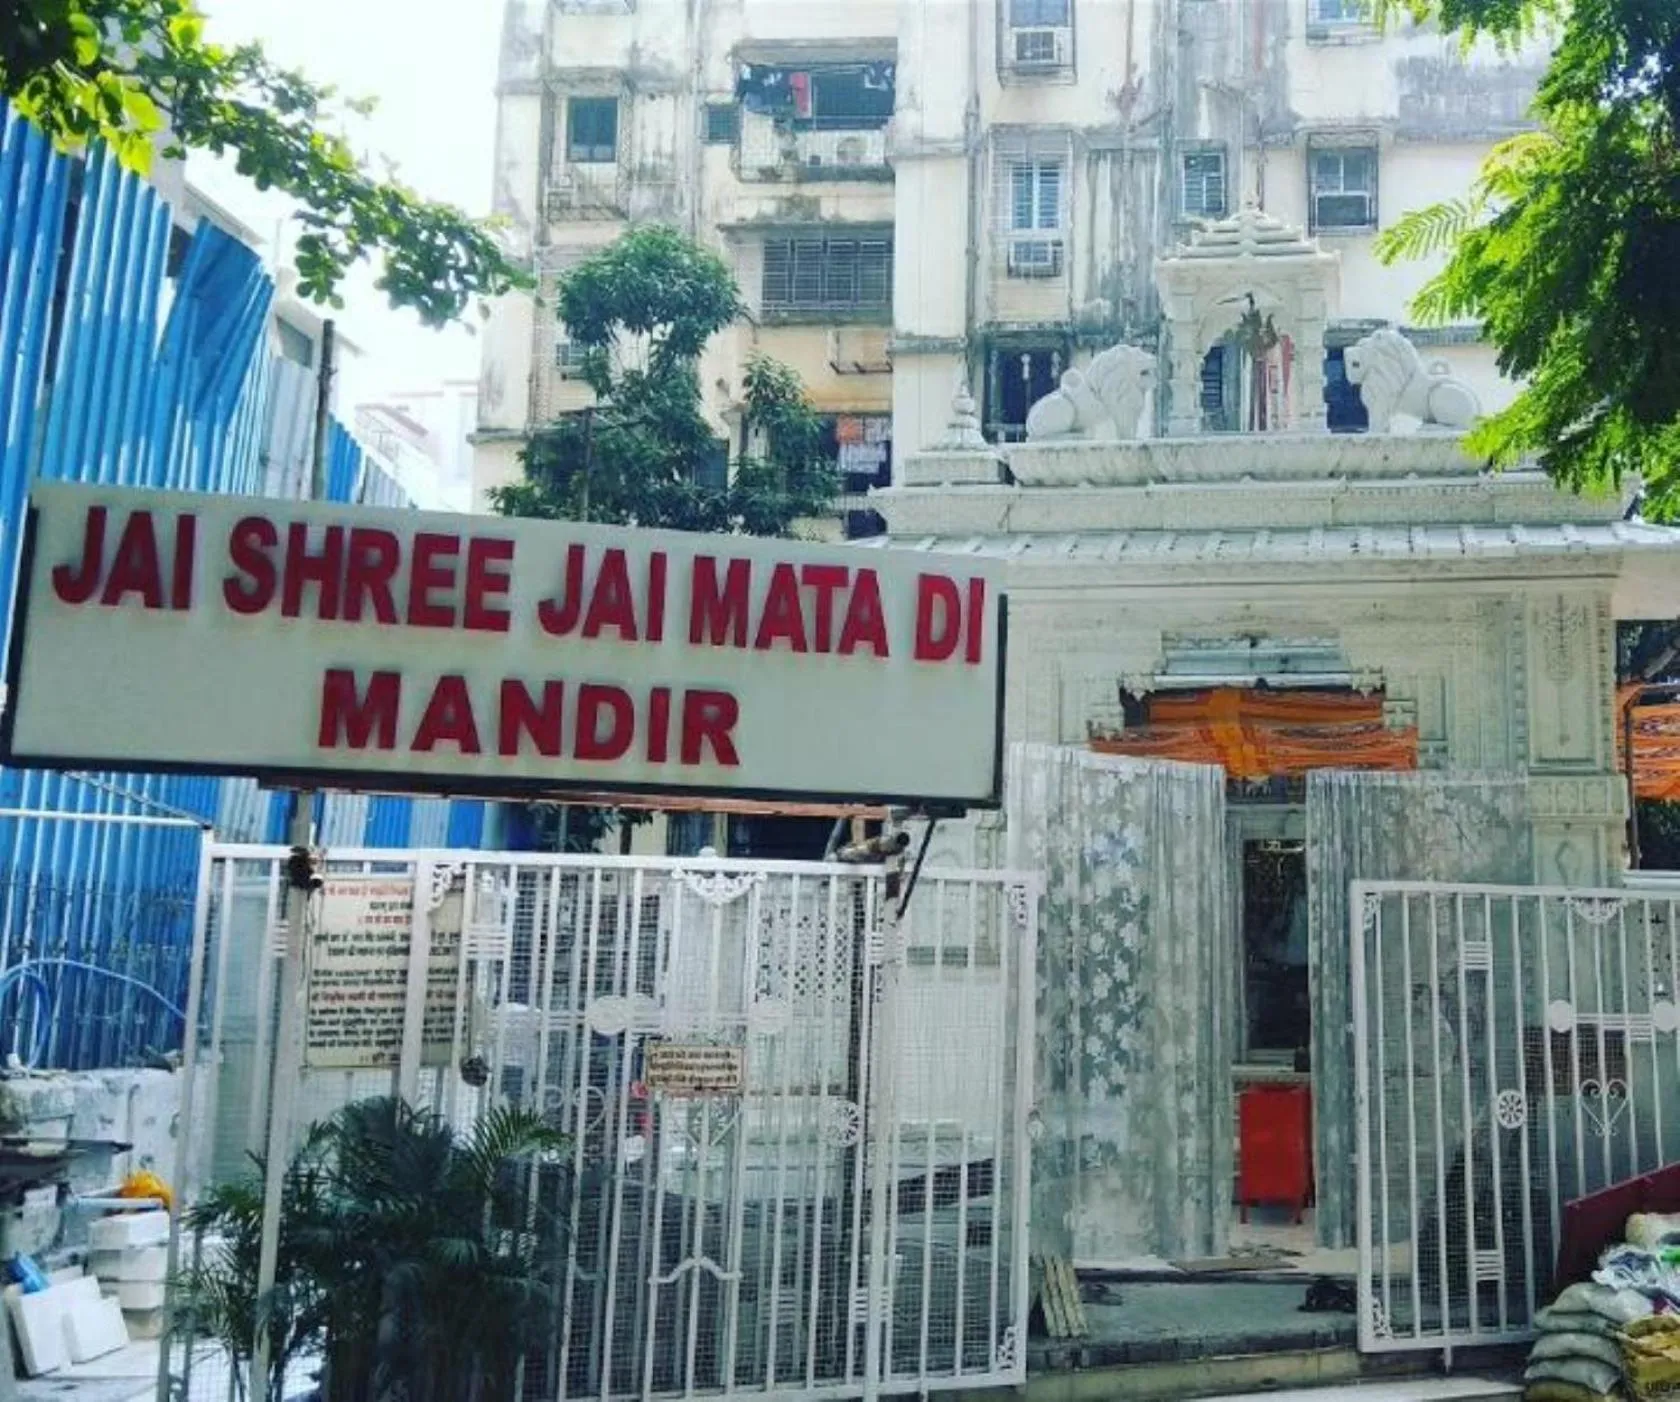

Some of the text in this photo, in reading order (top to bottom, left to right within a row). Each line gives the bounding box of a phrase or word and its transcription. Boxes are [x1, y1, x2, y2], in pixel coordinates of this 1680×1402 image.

[53, 506, 984, 664] JAI SHREE JAI MATA DI
[319, 670, 739, 765] MANDIR
